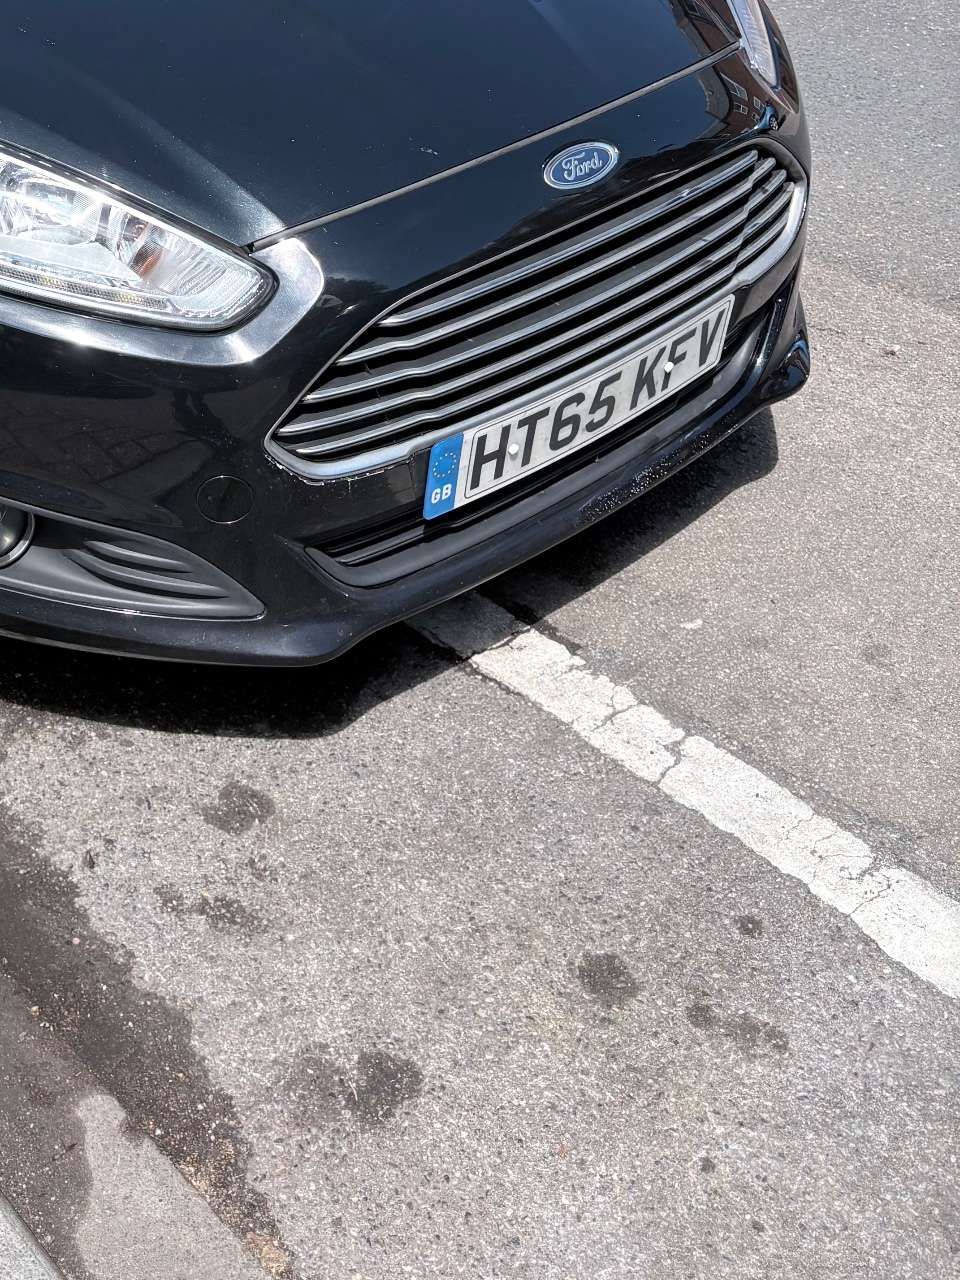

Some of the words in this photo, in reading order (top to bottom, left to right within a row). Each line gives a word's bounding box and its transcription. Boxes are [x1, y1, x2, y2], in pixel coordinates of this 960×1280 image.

[561, 151, 603, 181] Ford
[469, 370, 623, 491] HT65
[629, 308, 727, 411] KFV
[431, 483, 452, 504] GB
